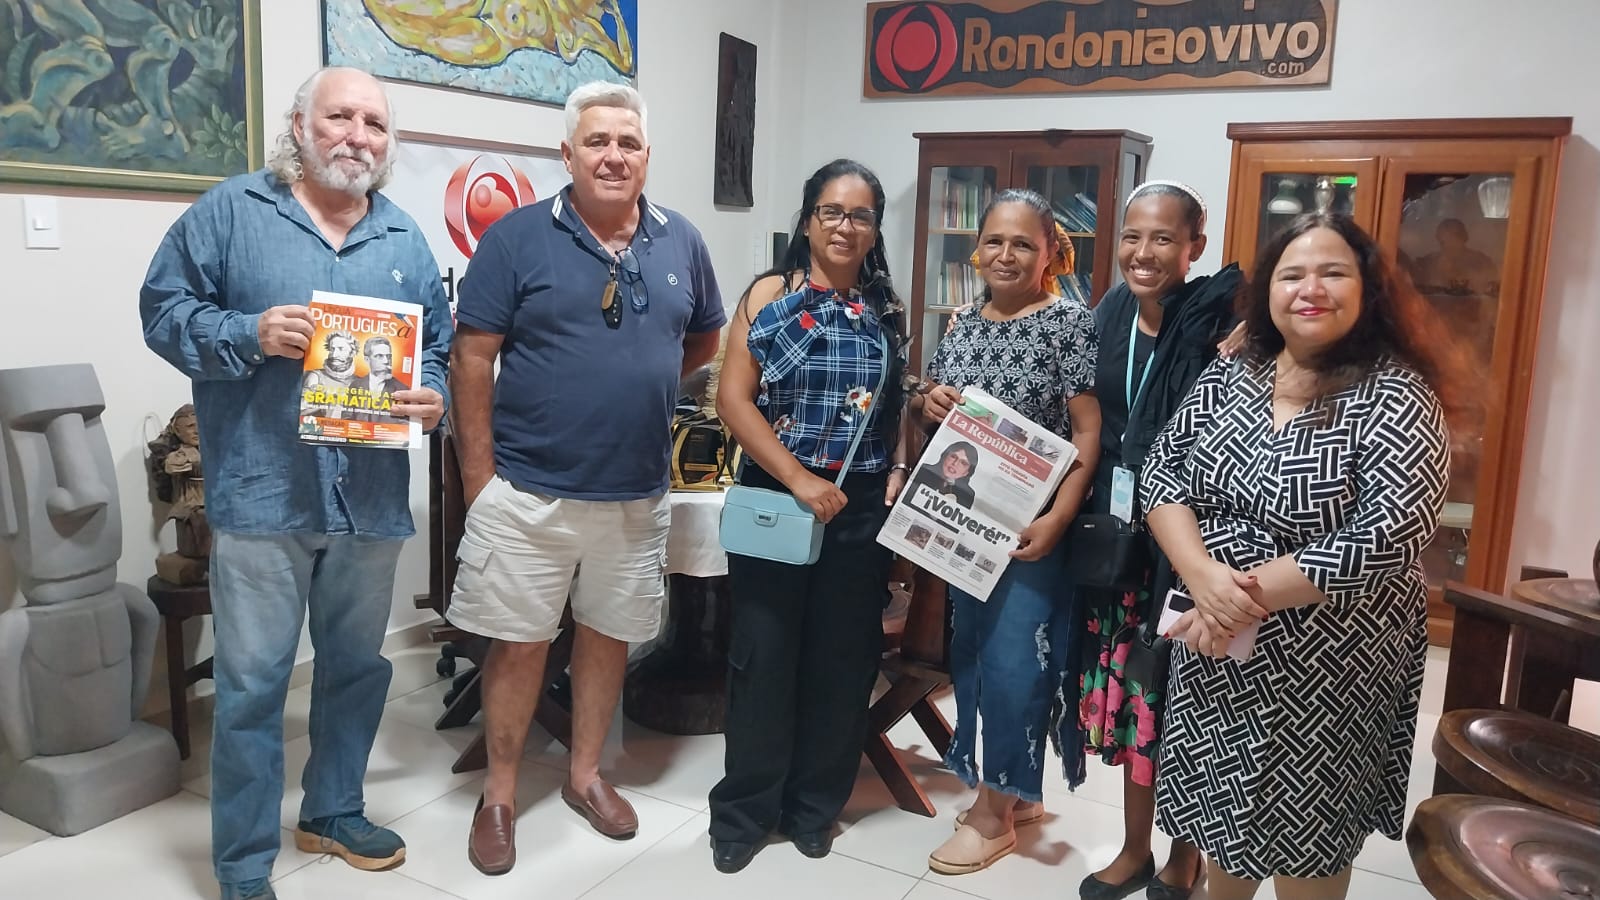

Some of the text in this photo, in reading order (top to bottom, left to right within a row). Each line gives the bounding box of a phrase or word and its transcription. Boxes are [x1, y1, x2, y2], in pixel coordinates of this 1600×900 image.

[962, 0, 1319, 73] Rondoniaovivo
[1261, 61, 1305, 75] .com
[951, 414, 1028, 465] La República
